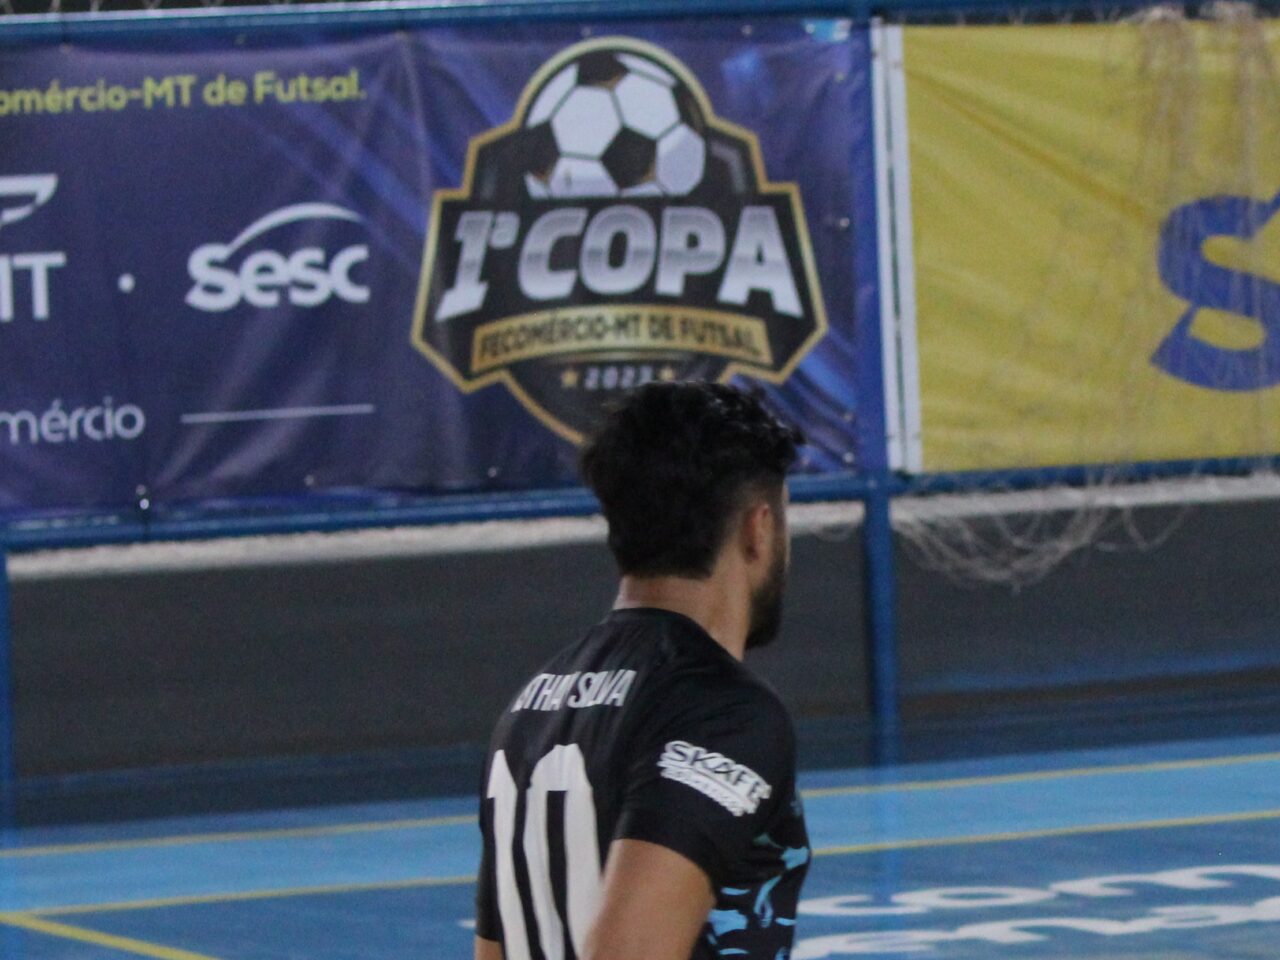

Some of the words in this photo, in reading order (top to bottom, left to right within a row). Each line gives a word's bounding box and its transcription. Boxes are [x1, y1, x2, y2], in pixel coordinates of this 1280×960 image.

[203, 74, 248, 106] de
[518, 205, 804, 320] COPA
[648, 314, 675, 341] DE
